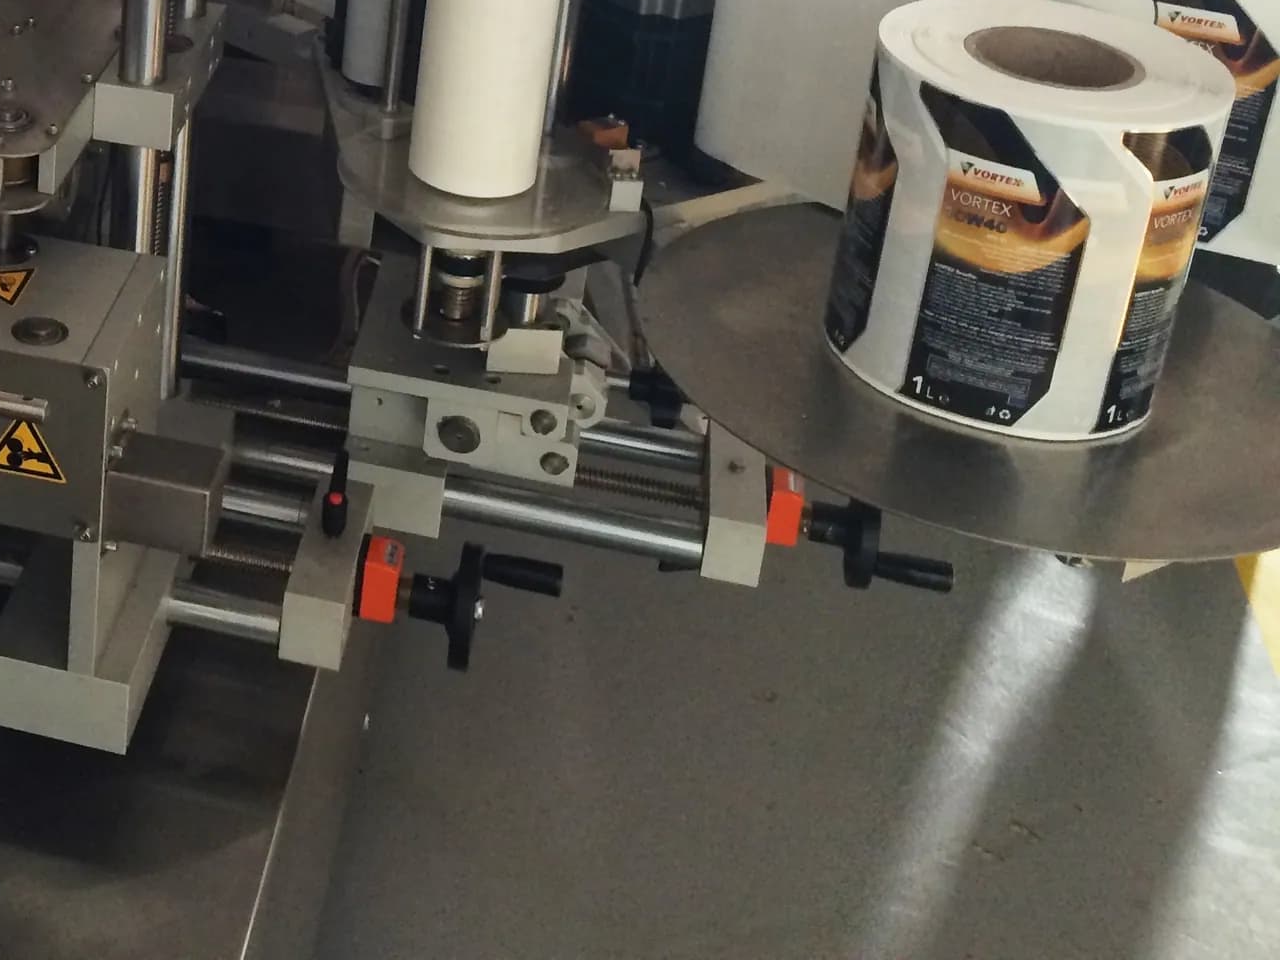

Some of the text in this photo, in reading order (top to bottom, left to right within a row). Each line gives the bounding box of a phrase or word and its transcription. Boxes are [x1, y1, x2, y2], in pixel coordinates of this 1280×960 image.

[973, 167, 1022, 187] VORTEX
[951, 188, 1013, 218] VORTEX
[912, 375, 924, 394] 1
[1107, 404, 1117, 424] 1
